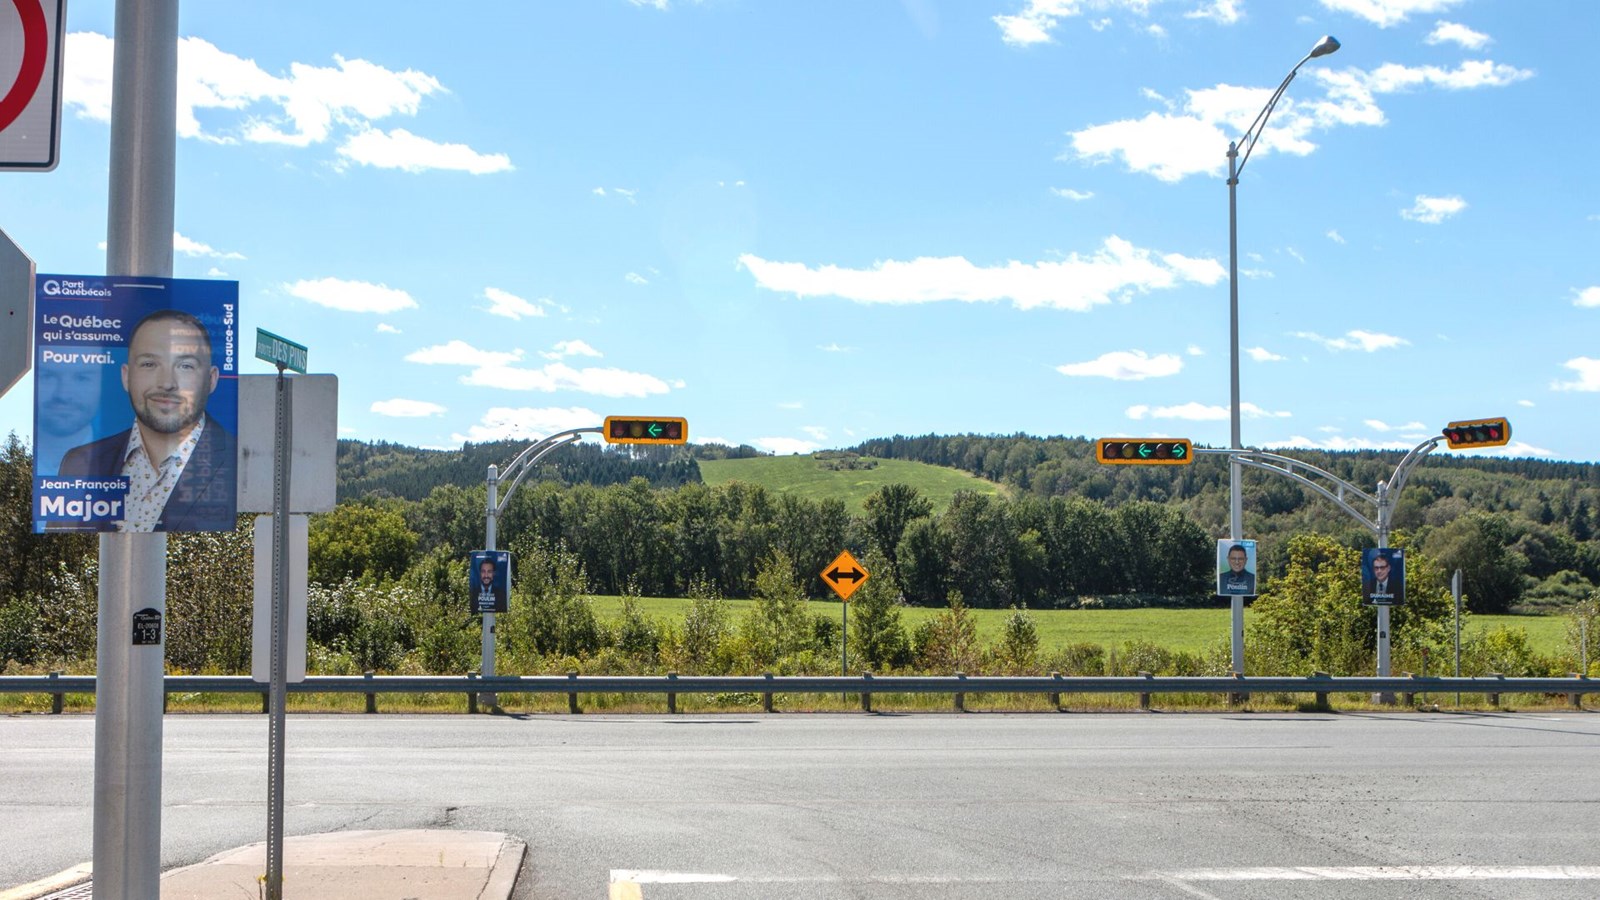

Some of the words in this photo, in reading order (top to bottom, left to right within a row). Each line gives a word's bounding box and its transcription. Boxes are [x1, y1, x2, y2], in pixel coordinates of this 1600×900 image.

[62, 280, 84, 288] Parti
[62, 287, 112, 297] Québécois
[43, 314, 58, 324] Le
[60, 314, 121, 328] Québec
[43, 329, 62, 342] qui
[65, 330, 124, 342] s'assume.
[223, 303, 234, 371] Beauce-Sud
[43, 350, 79, 364] Pour
[81, 350, 115, 364] vrai.
[272, 338, 288, 363] DES
[289, 345, 307, 370] PINS
[40, 479, 127, 492] Jean-François
[40, 494, 122, 522] Major
[141, 629, 156, 640] 1-3
